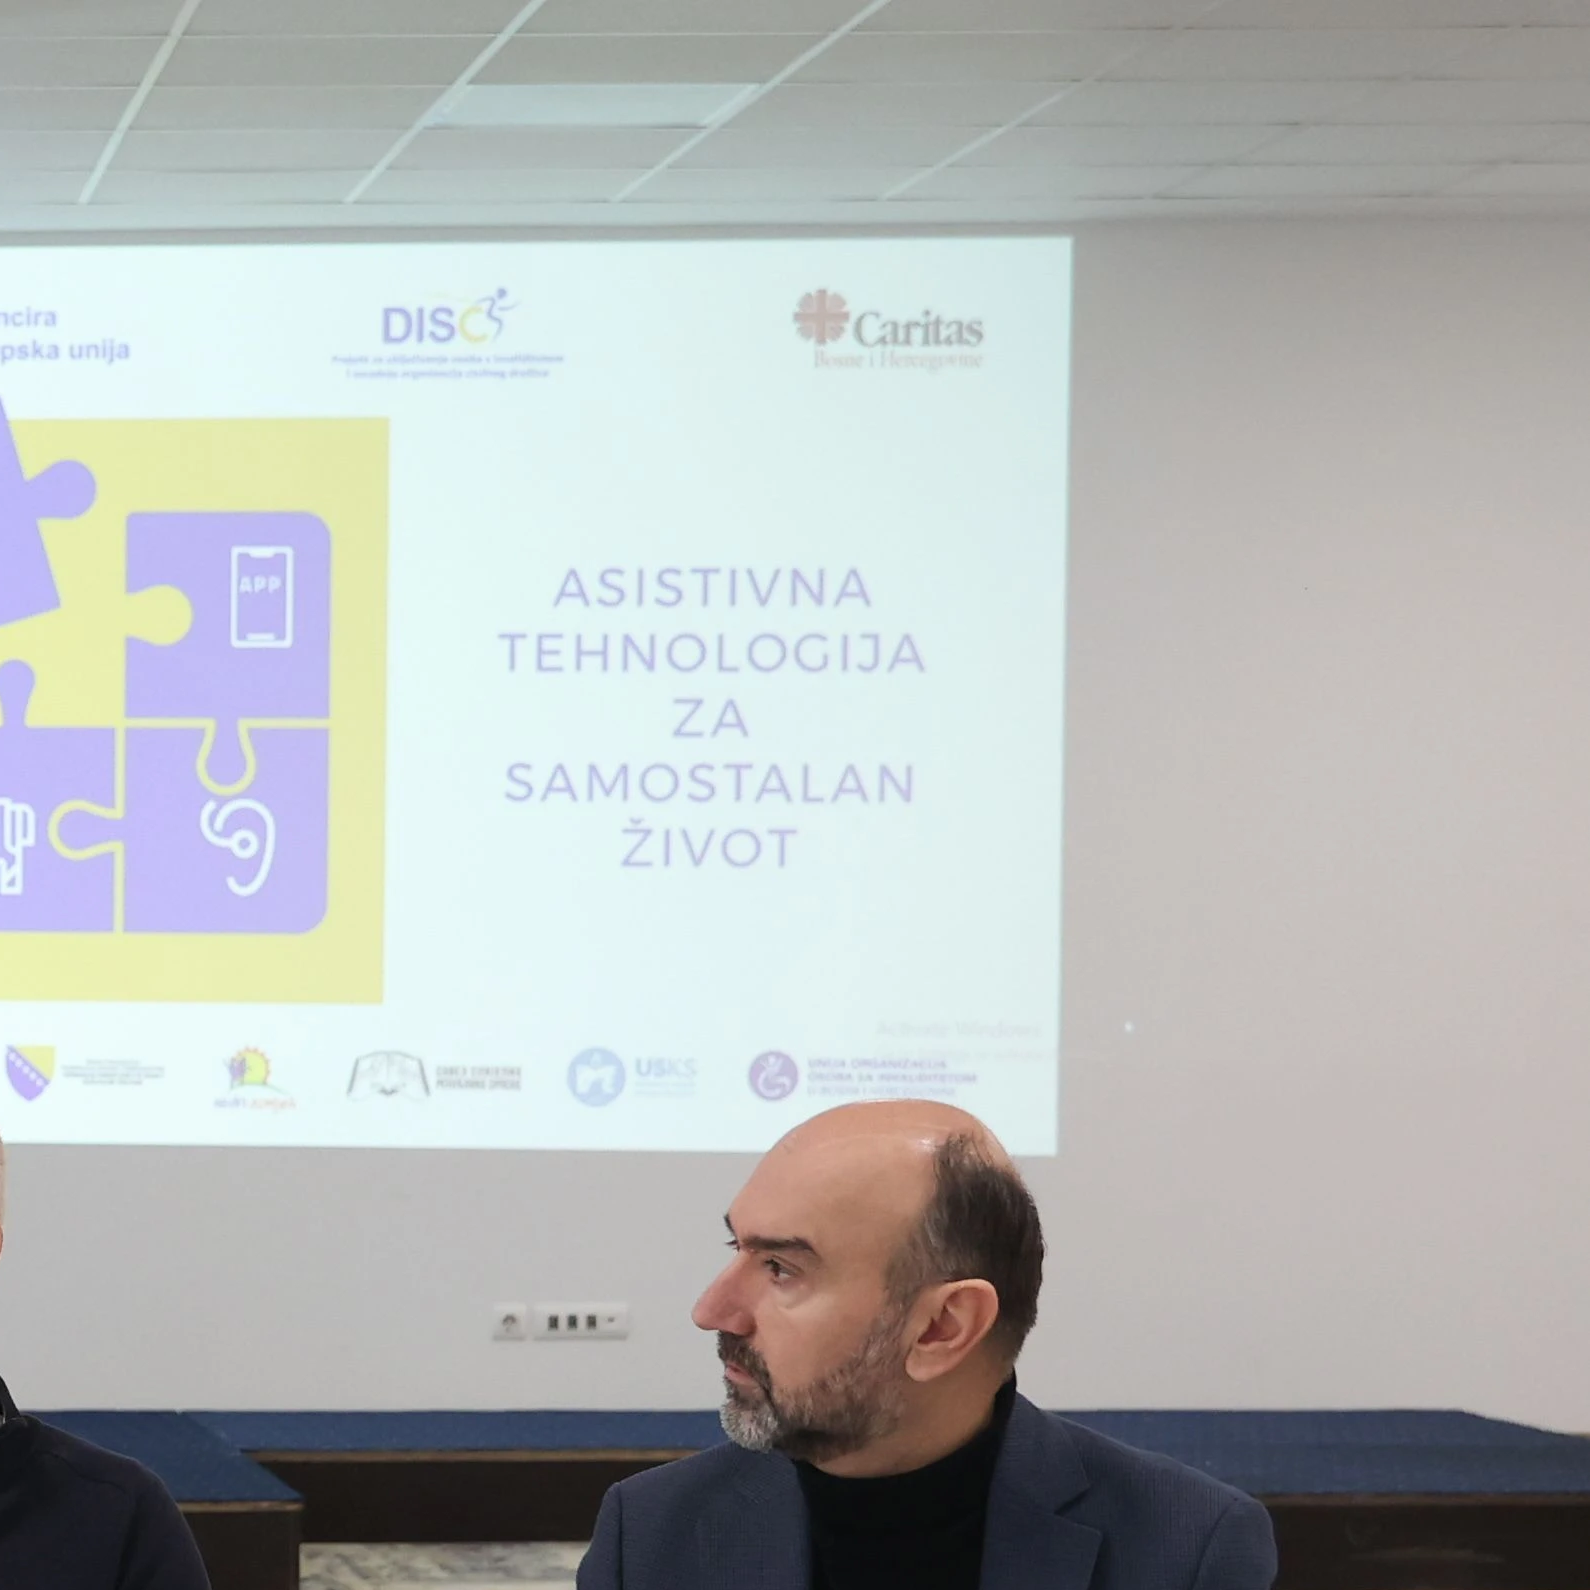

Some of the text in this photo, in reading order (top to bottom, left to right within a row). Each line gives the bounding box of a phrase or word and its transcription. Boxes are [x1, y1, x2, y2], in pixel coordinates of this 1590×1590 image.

[382, 305, 490, 344] DISC
[852, 309, 985, 348] Caritas
[68, 339, 130, 364] unija
[238, 576, 282, 594] APP
[552, 566, 872, 608] ASISTIVNA
[498, 632, 926, 674] TEHNOLOGIJA
[672, 697, 750, 738] ZA
[504, 762, 916, 804] SAMOSTALAN
[621, 816, 799, 869] ŽIVOT
